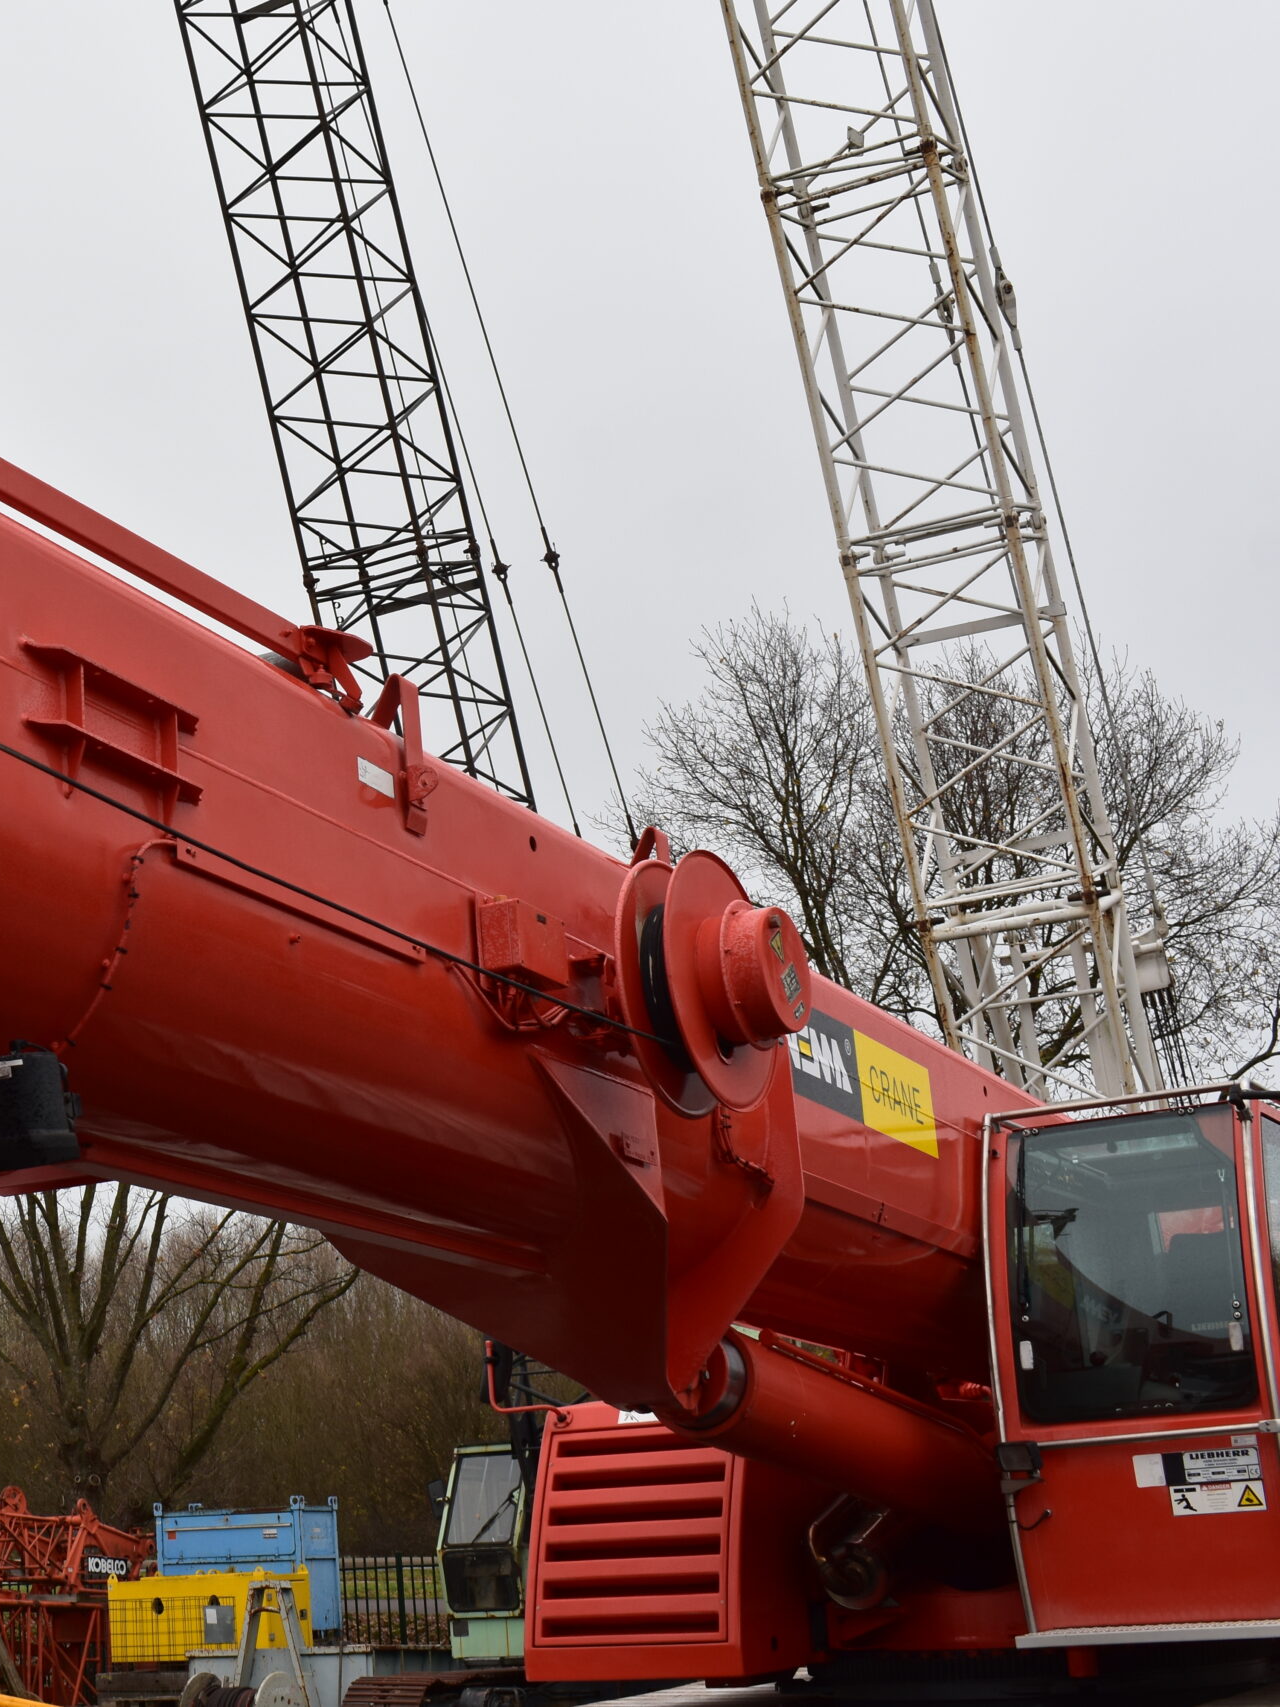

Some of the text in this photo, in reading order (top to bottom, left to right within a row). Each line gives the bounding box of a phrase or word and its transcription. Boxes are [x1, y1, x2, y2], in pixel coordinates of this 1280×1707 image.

[869, 1065, 925, 1125] CRANE
[1189, 1449, 1250, 1460] LIEBHERR
[1207, 1483, 1231, 1491] DANGER
[88, 1556, 127, 1575] KOBELCO
